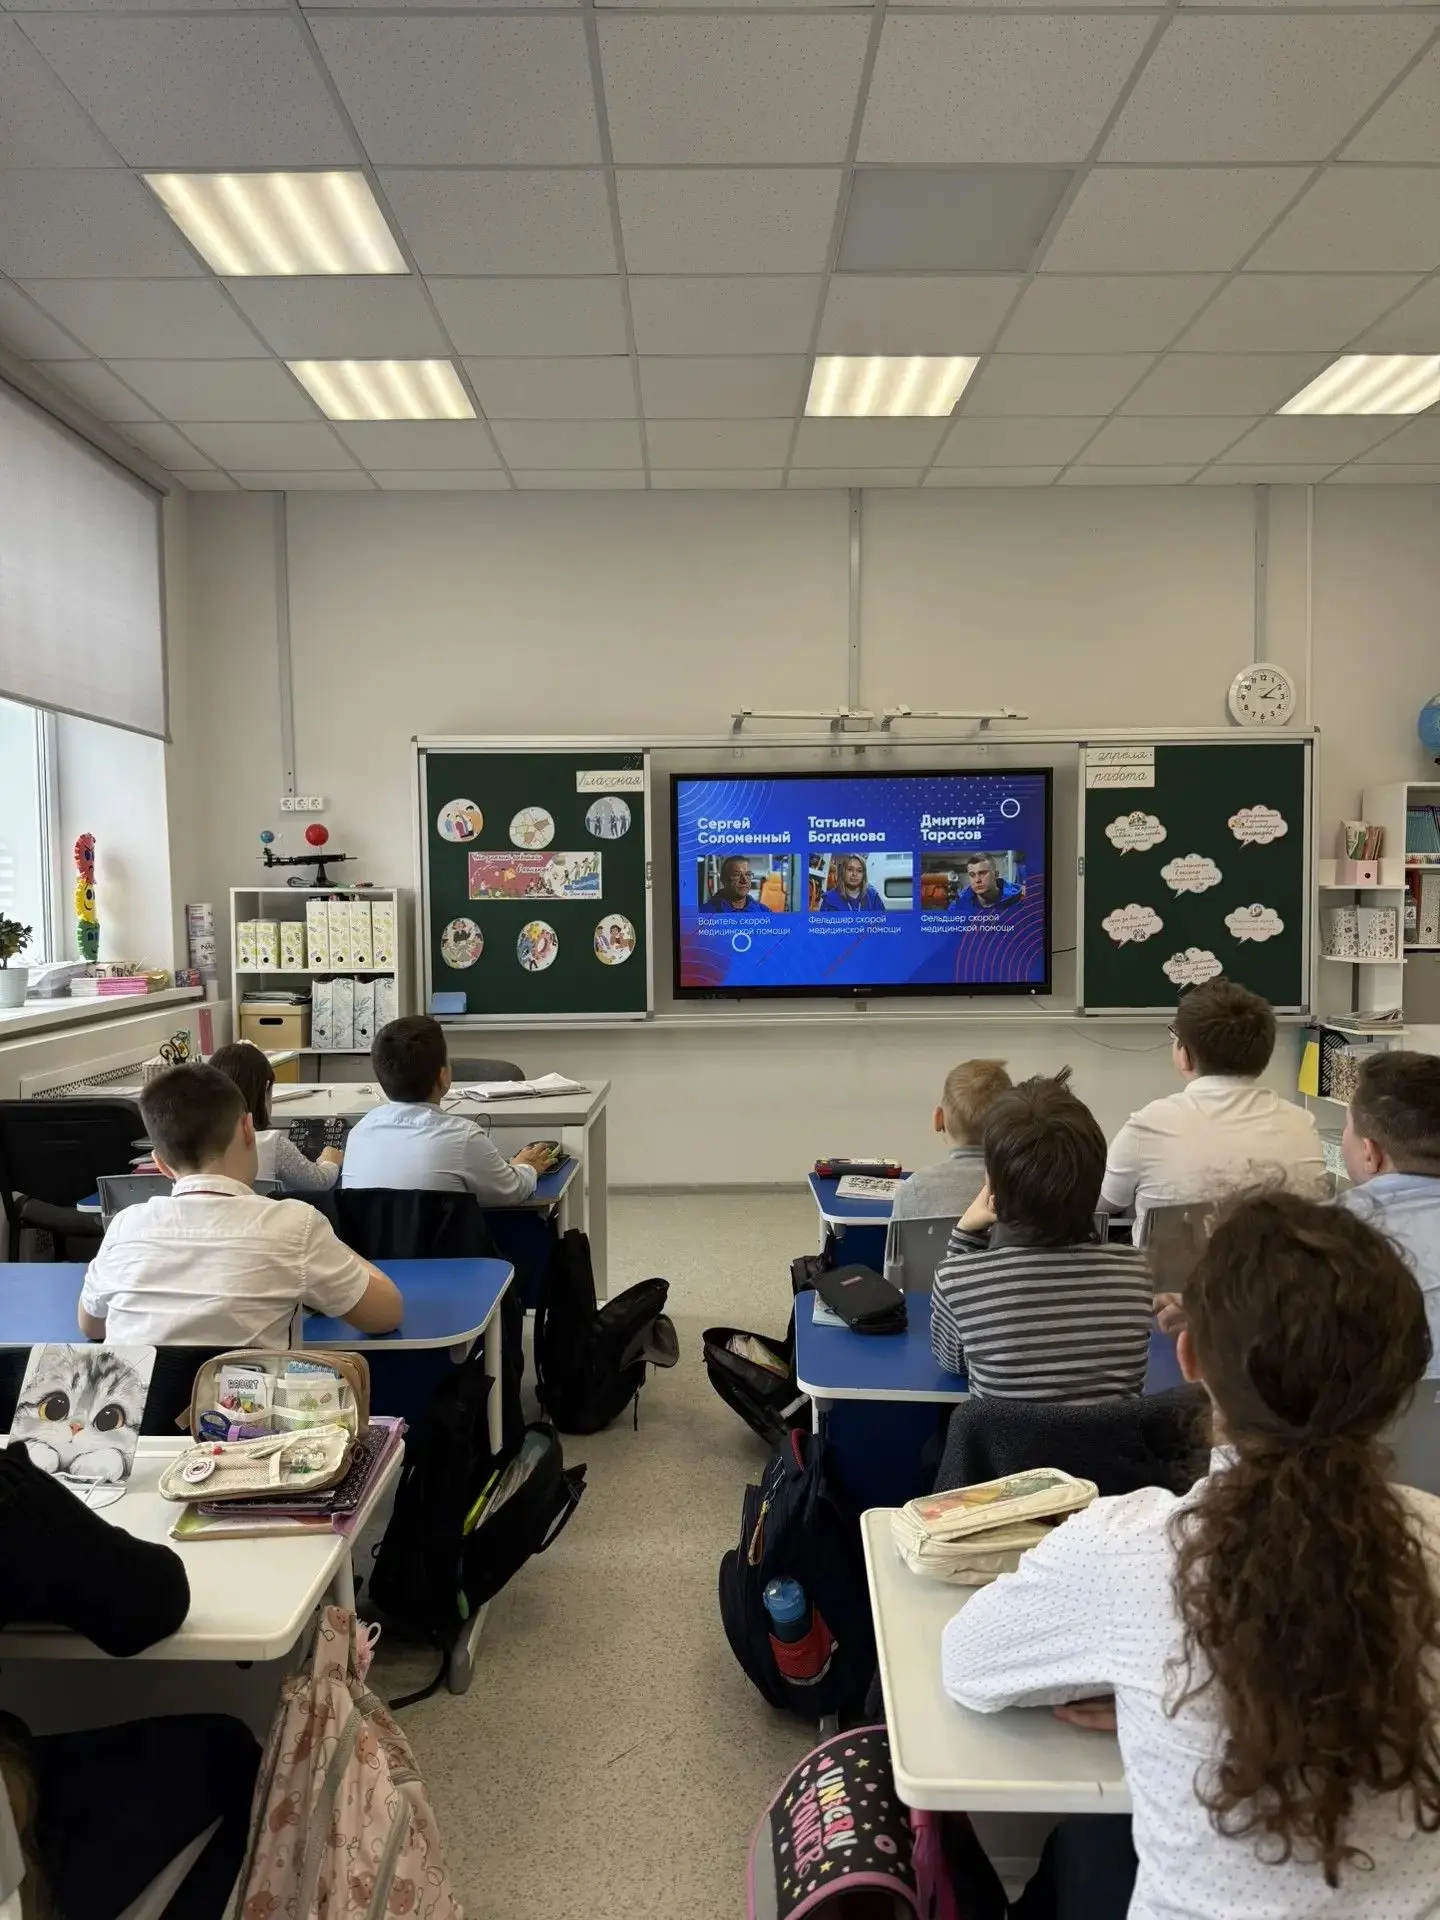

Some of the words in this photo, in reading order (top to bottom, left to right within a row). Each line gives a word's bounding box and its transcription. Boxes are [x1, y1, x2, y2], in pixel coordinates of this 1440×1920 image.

[1092, 766, 1147, 788] работа
[697, 817, 750, 832] Сергей
[808, 816, 865, 828] Татьяна
[921, 814, 985, 828] Дмитрий
[697, 830, 790, 844] Соломенный
[808, 830, 886, 844] Богданова
[921, 828, 982, 842] Тарасов
[698, 917, 737, 926] Водитель
[739, 917, 770, 926] скорой
[809, 915, 853, 925] Фельдшер
[856, 915, 886, 924] скорой
[921, 913, 966, 924] Фельдшер
[969, 913, 999, 923] скорой
[698, 926, 754, 937] медицинской
[757, 926, 790, 936] помощи
[809, 926, 864, 935] медицинской
[867, 925, 902, 934] помощи
[921, 924, 977, 934] медицинской
[980, 924, 1015, 933] помощи
[790, 1782, 824, 1874] POWER
